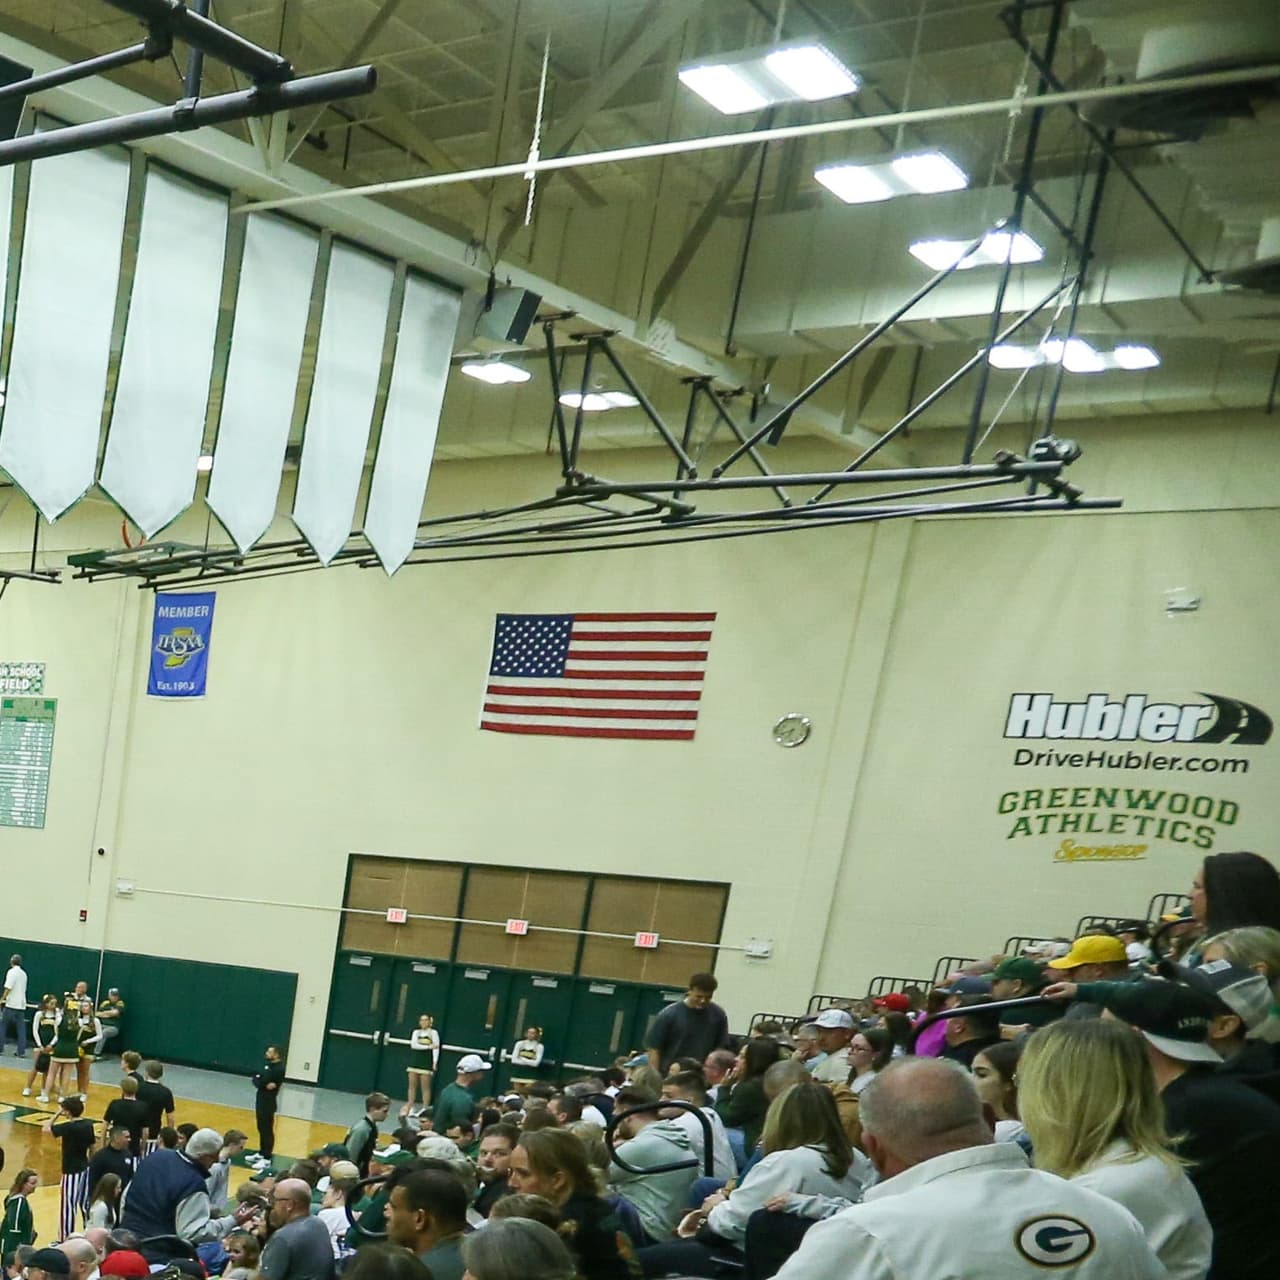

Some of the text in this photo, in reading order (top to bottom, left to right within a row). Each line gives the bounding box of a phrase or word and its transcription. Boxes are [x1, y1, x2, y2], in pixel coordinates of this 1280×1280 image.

[158, 606, 209, 618] MEMBER
[0, 678, 30, 690] FIELD
[1003, 693, 1215, 743] Hubler
[1013, 749, 1250, 774] DriveHubler.com
[997, 787, 1240, 826] GREENWOOD
[1006, 814, 1216, 850] ATHLETICS
[1017, 1215, 1094, 1267] G
